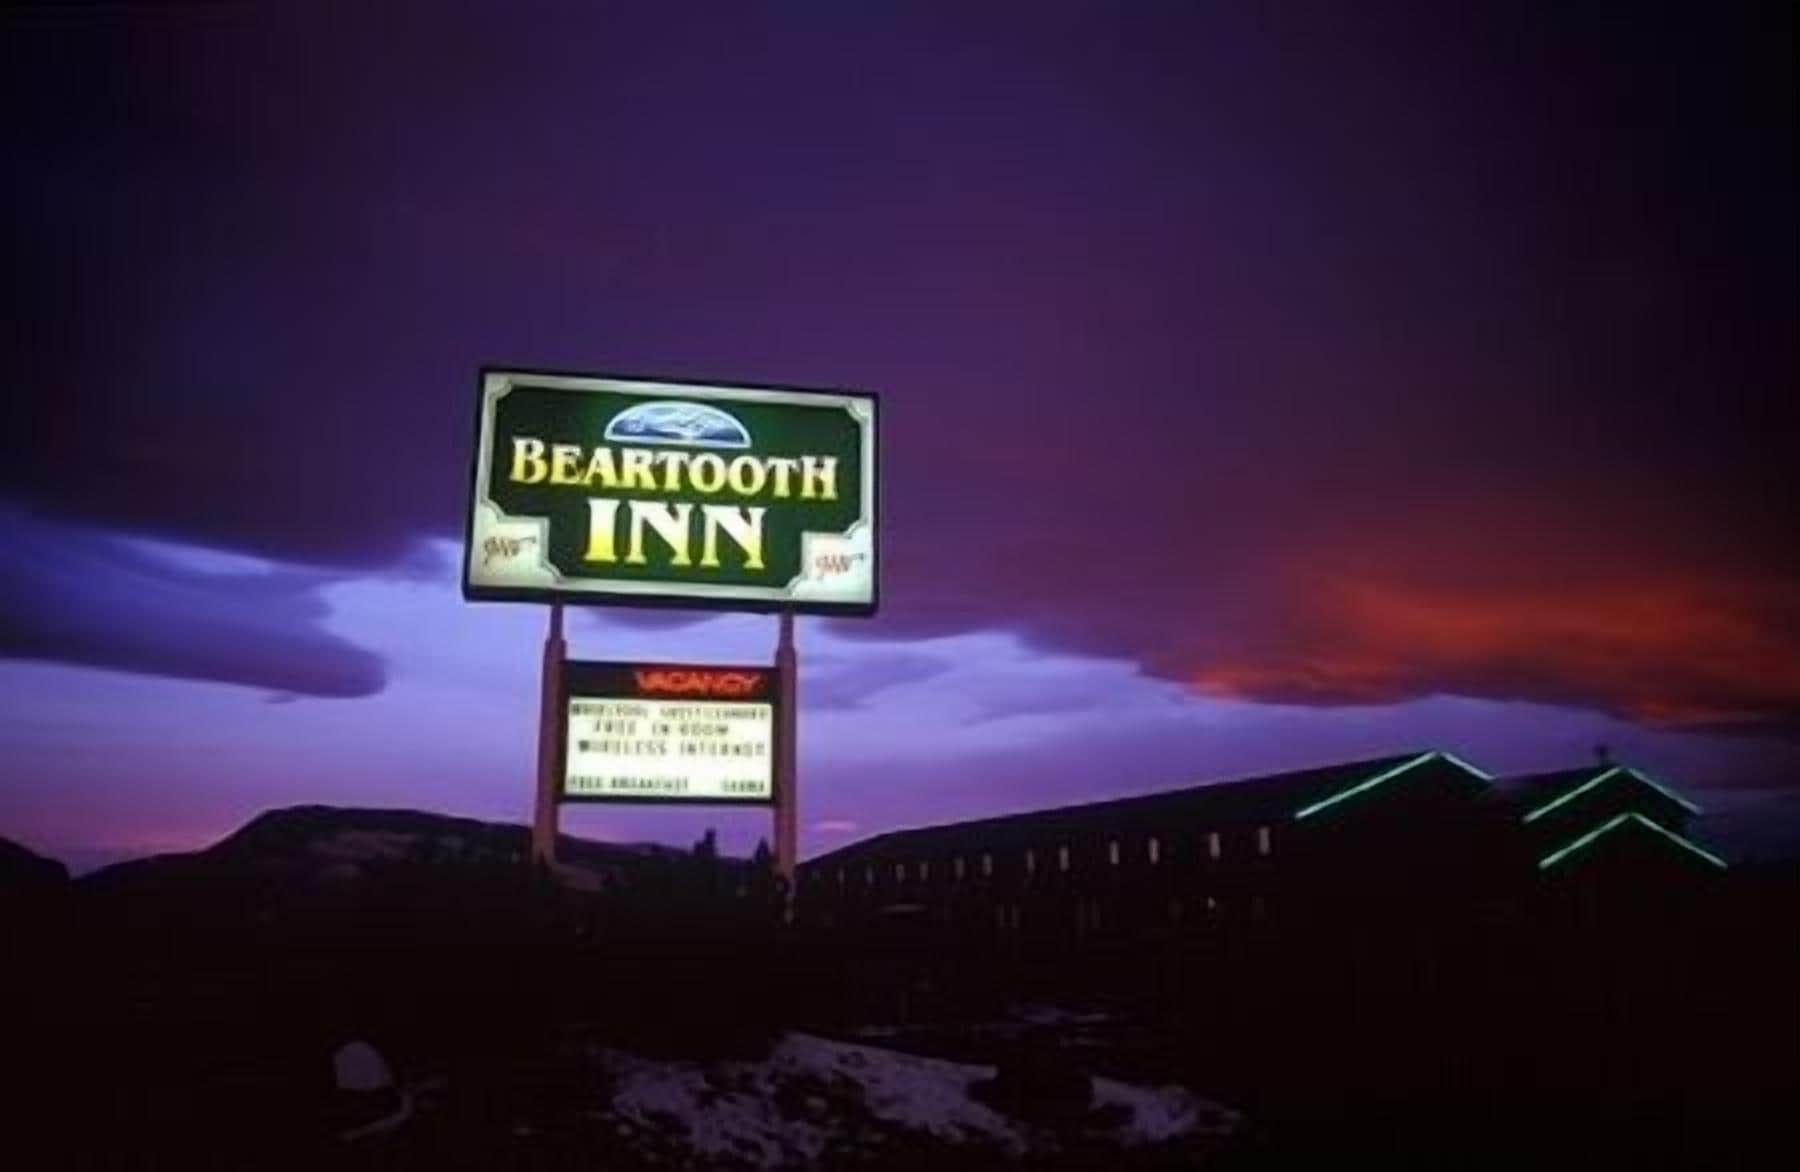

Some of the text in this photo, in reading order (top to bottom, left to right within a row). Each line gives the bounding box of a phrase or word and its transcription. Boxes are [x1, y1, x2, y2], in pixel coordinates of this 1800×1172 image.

[509, 436, 839, 500] BEARTOOTH
[583, 497, 767, 570] INN
[634, 671, 762, 693] VACANCY
